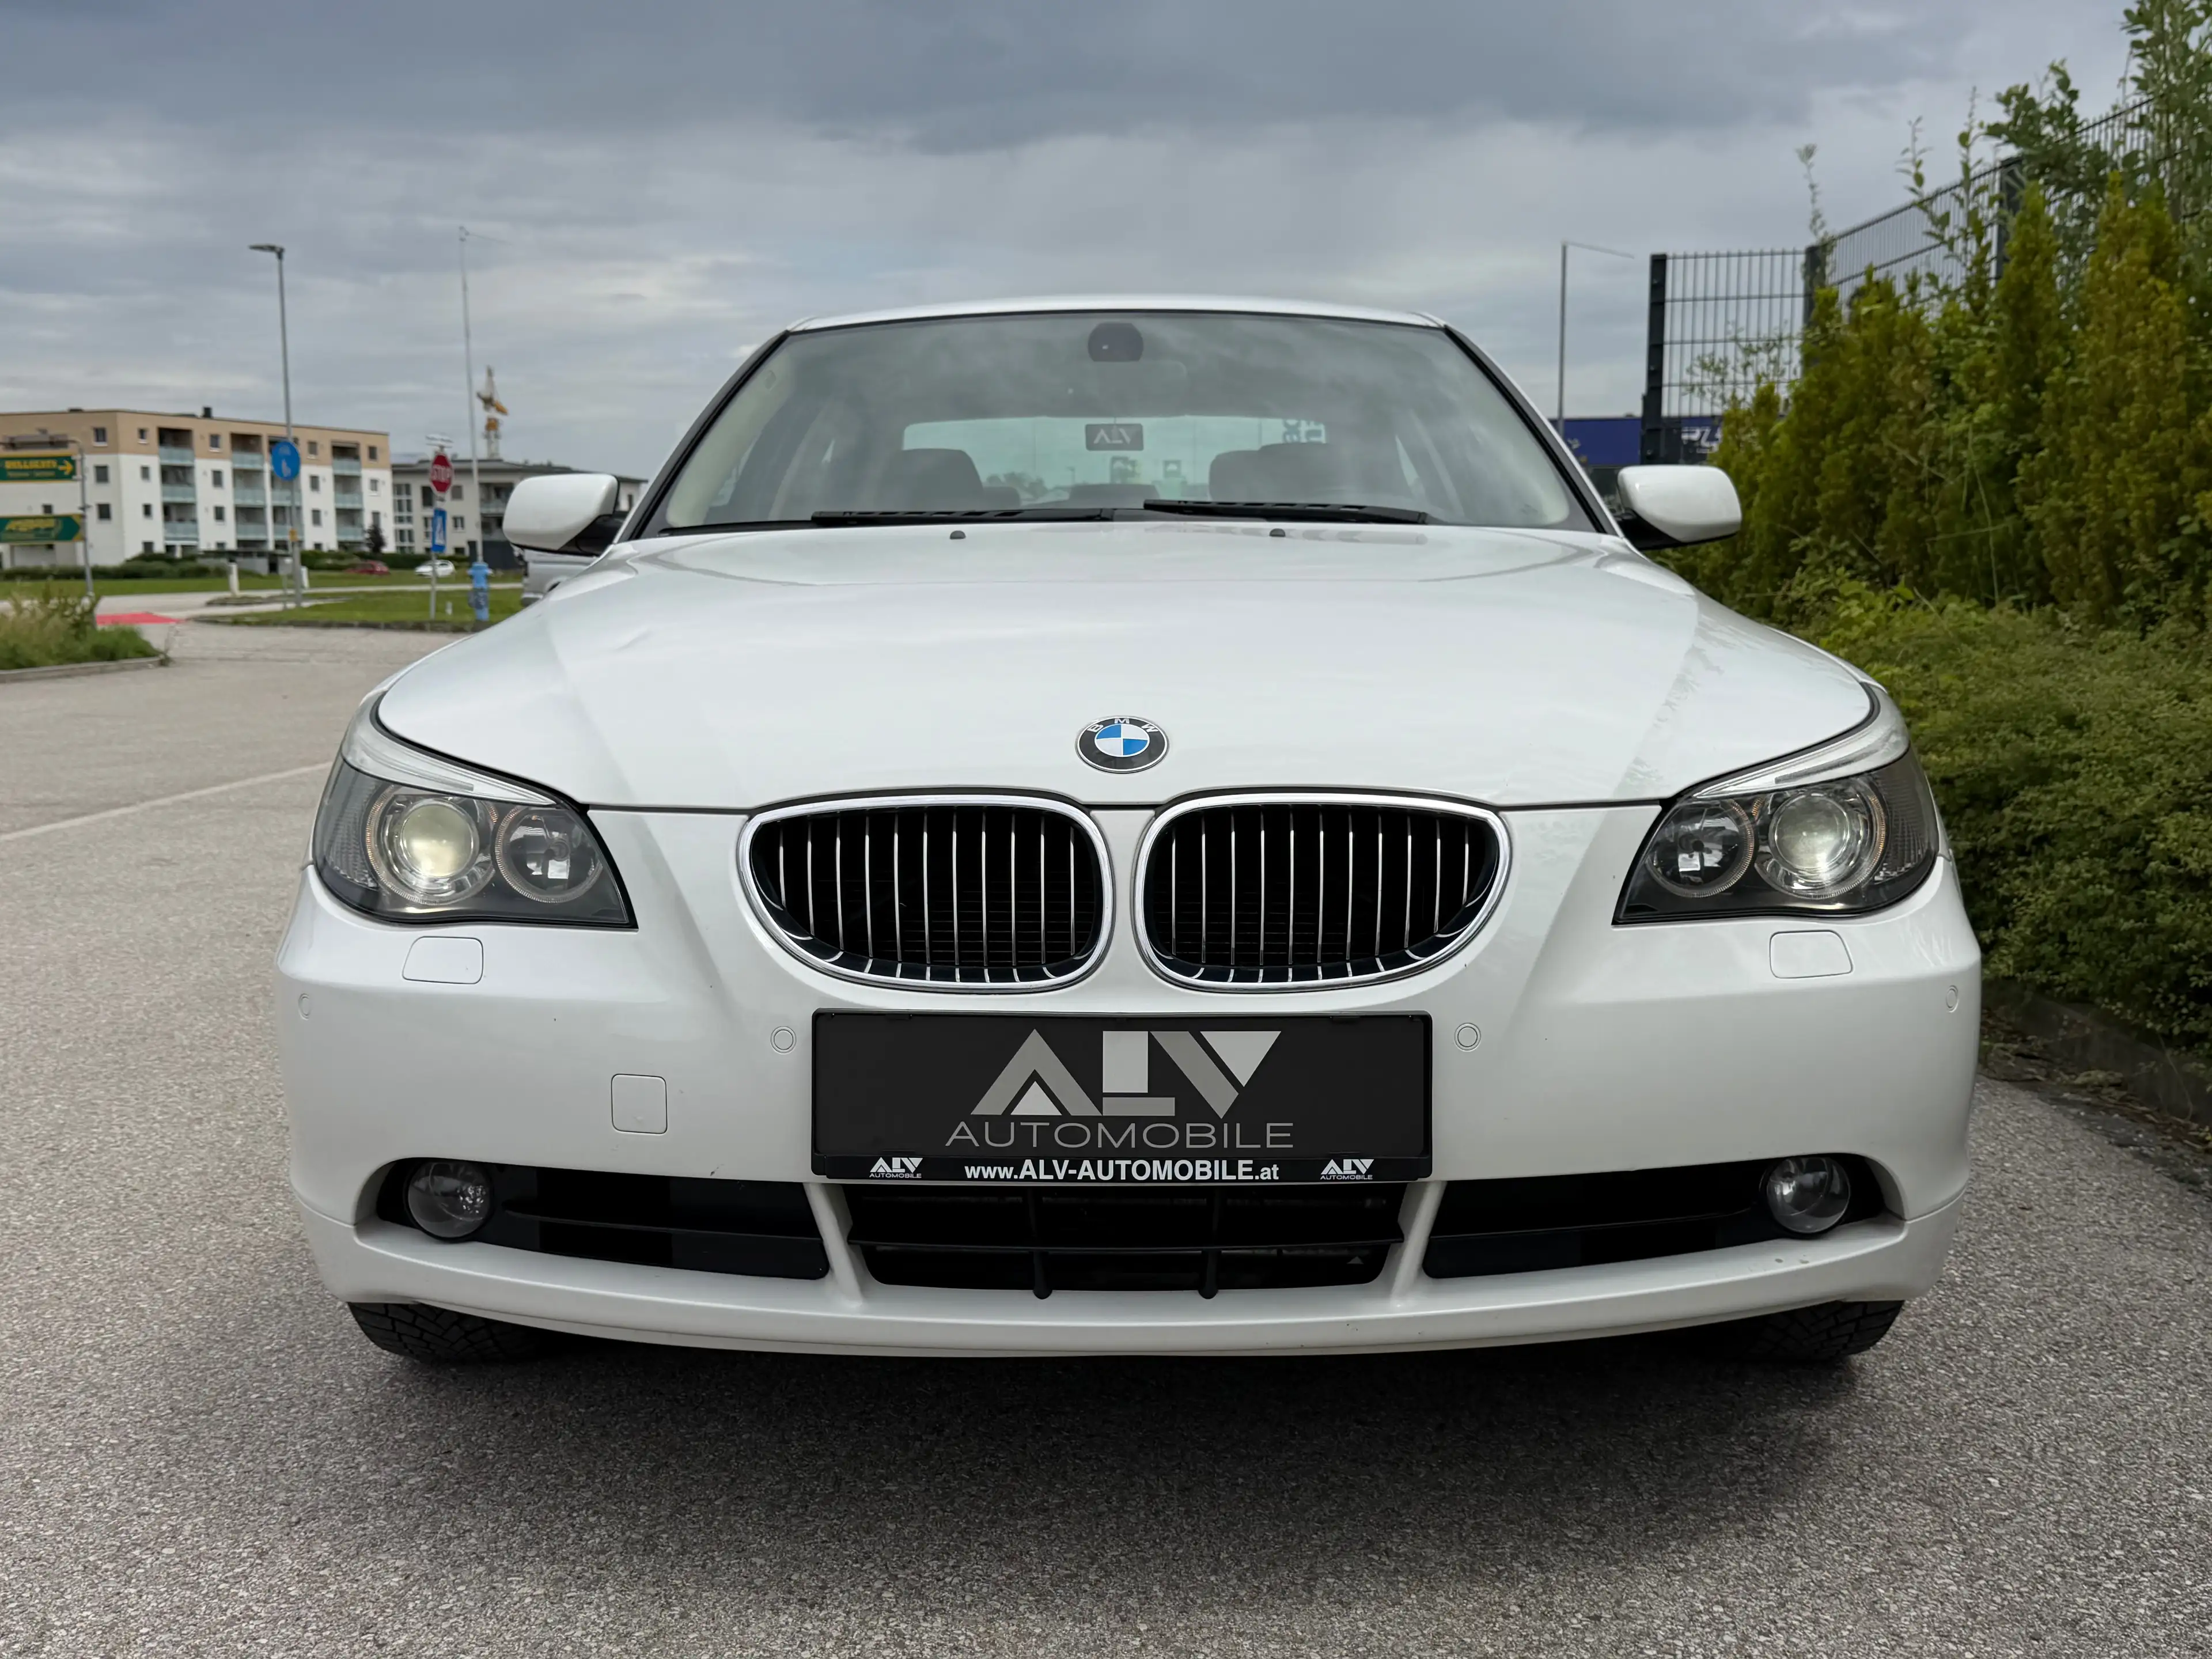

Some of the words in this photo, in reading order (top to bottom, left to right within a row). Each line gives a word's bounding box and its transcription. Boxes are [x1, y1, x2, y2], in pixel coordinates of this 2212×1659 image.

[432, 464, 451, 483] STOP
[1086, 718, 1159, 733] BMW
[971, 1029, 1282, 1119] ALV
[945, 1121, 1294, 1149] AUTOMOBILE
[870, 1157, 923, 1173] ALV
[965, 1160, 1279, 1181] www.ALV-AUTOMOBILE.at
[1320, 1159, 1374, 1175] ALV
